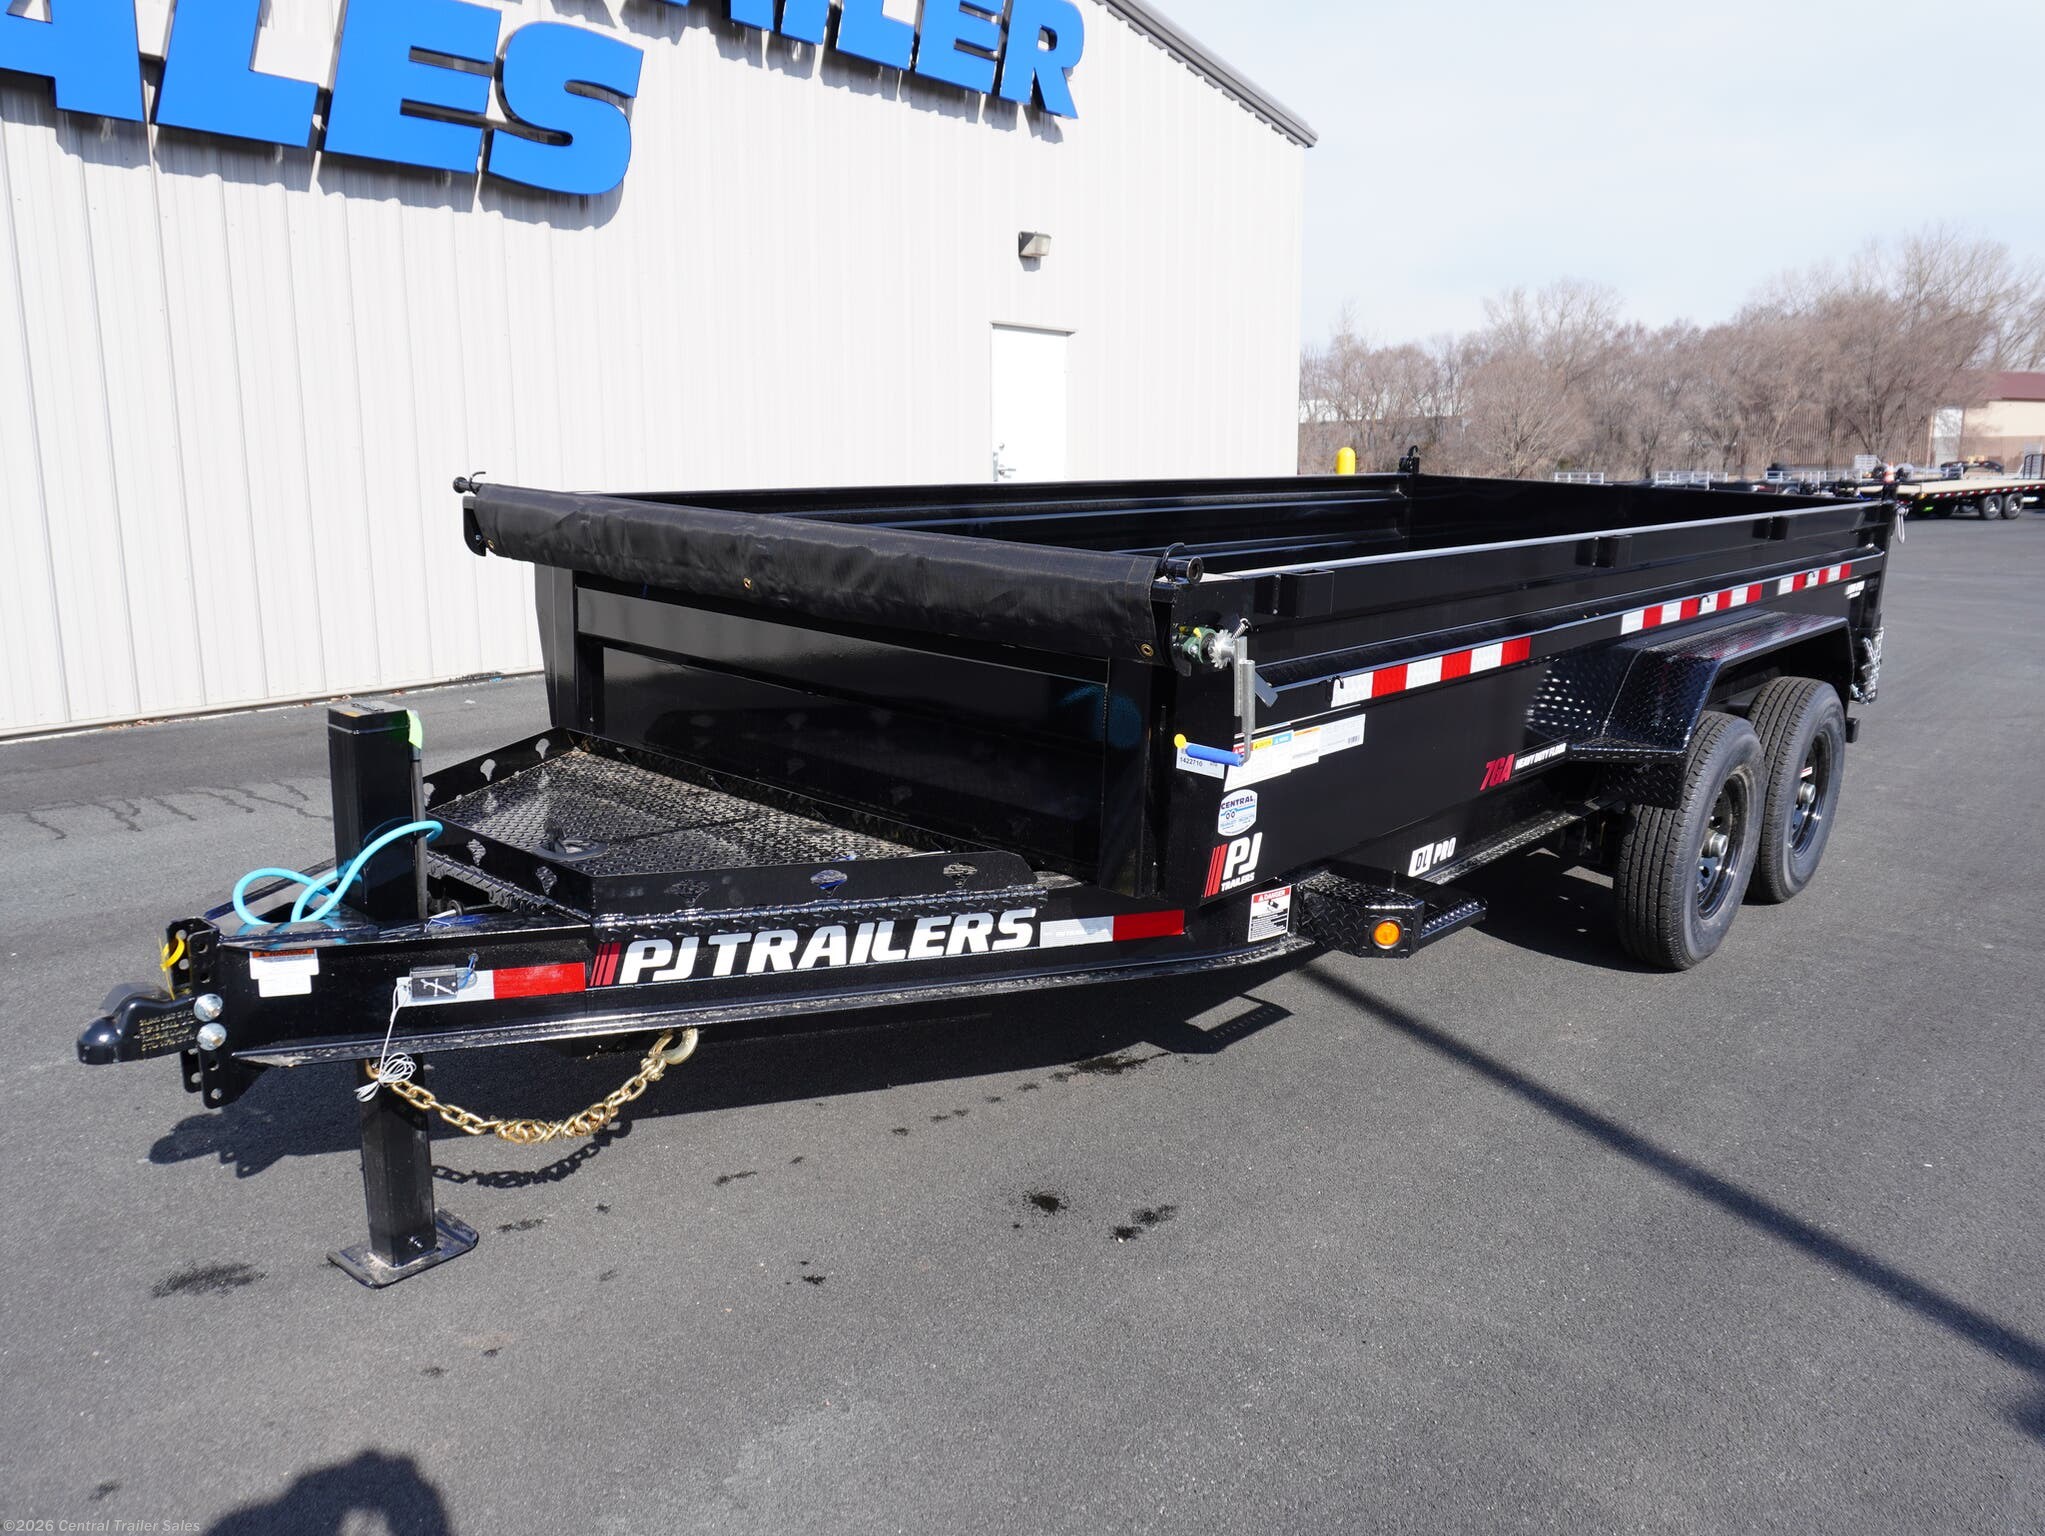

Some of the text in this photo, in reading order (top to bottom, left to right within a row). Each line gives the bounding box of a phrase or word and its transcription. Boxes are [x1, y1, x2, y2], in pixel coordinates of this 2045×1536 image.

[1220, 795, 1254, 810] CENTRAL
[1222, 832, 1263, 881] PJ
[1432, 836, 1457, 865] PRO
[1221, 871, 1255, 892] TRAILERS
[619, 907, 1036, 984] PJ TRAILERS
